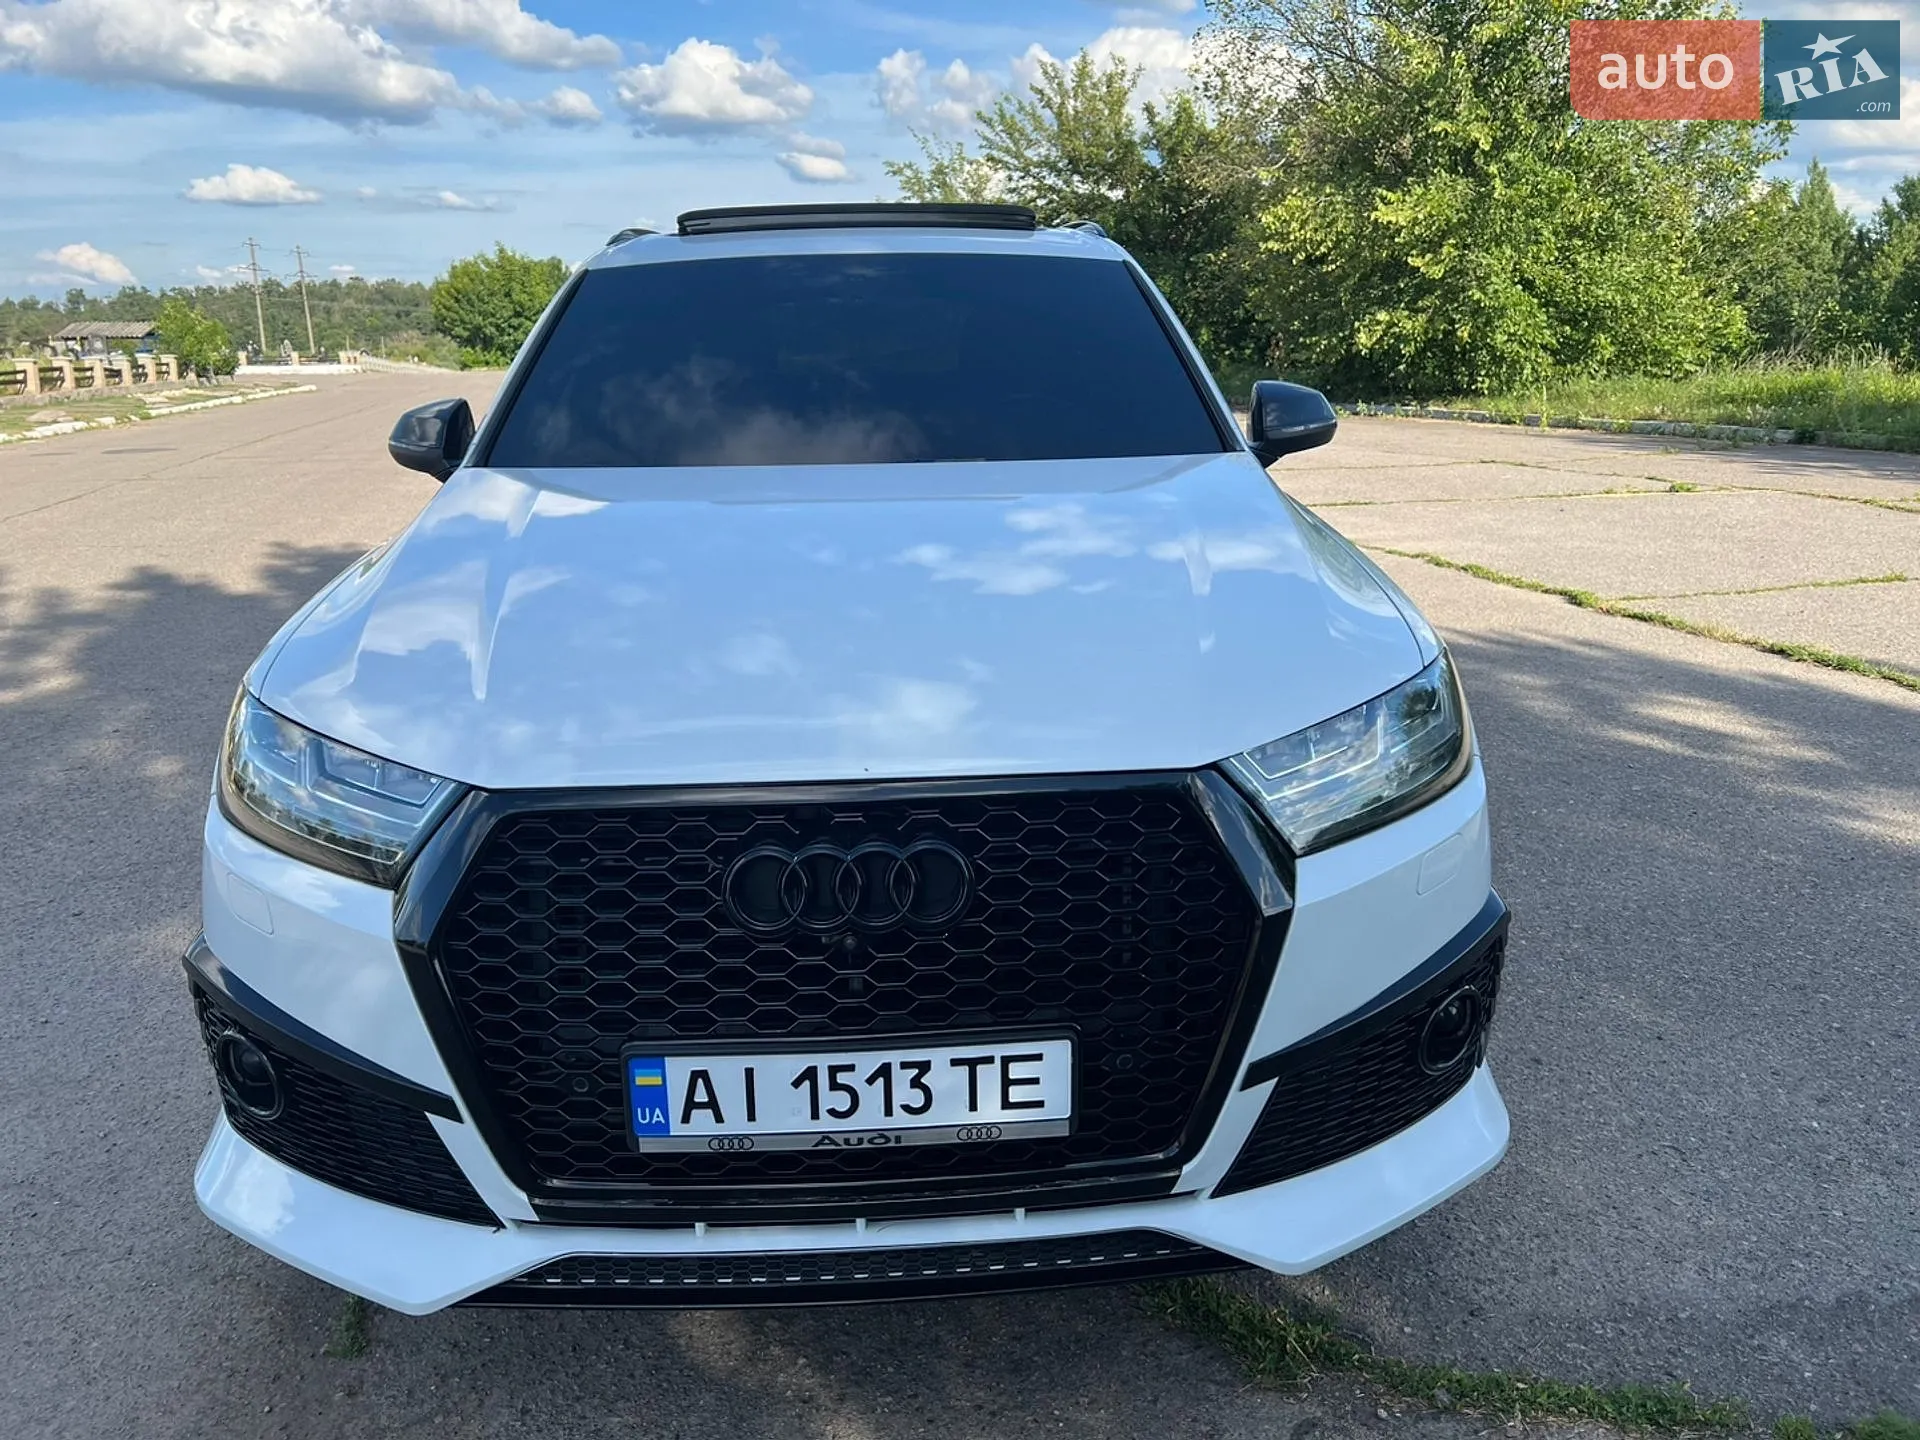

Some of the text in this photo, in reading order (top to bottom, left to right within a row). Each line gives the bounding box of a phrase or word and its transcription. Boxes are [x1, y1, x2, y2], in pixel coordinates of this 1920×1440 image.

[680, 1053, 1045, 1124] AI 1513 TE
[637, 1107, 665, 1124] UA
[810, 1132, 902, 1148] Audi
